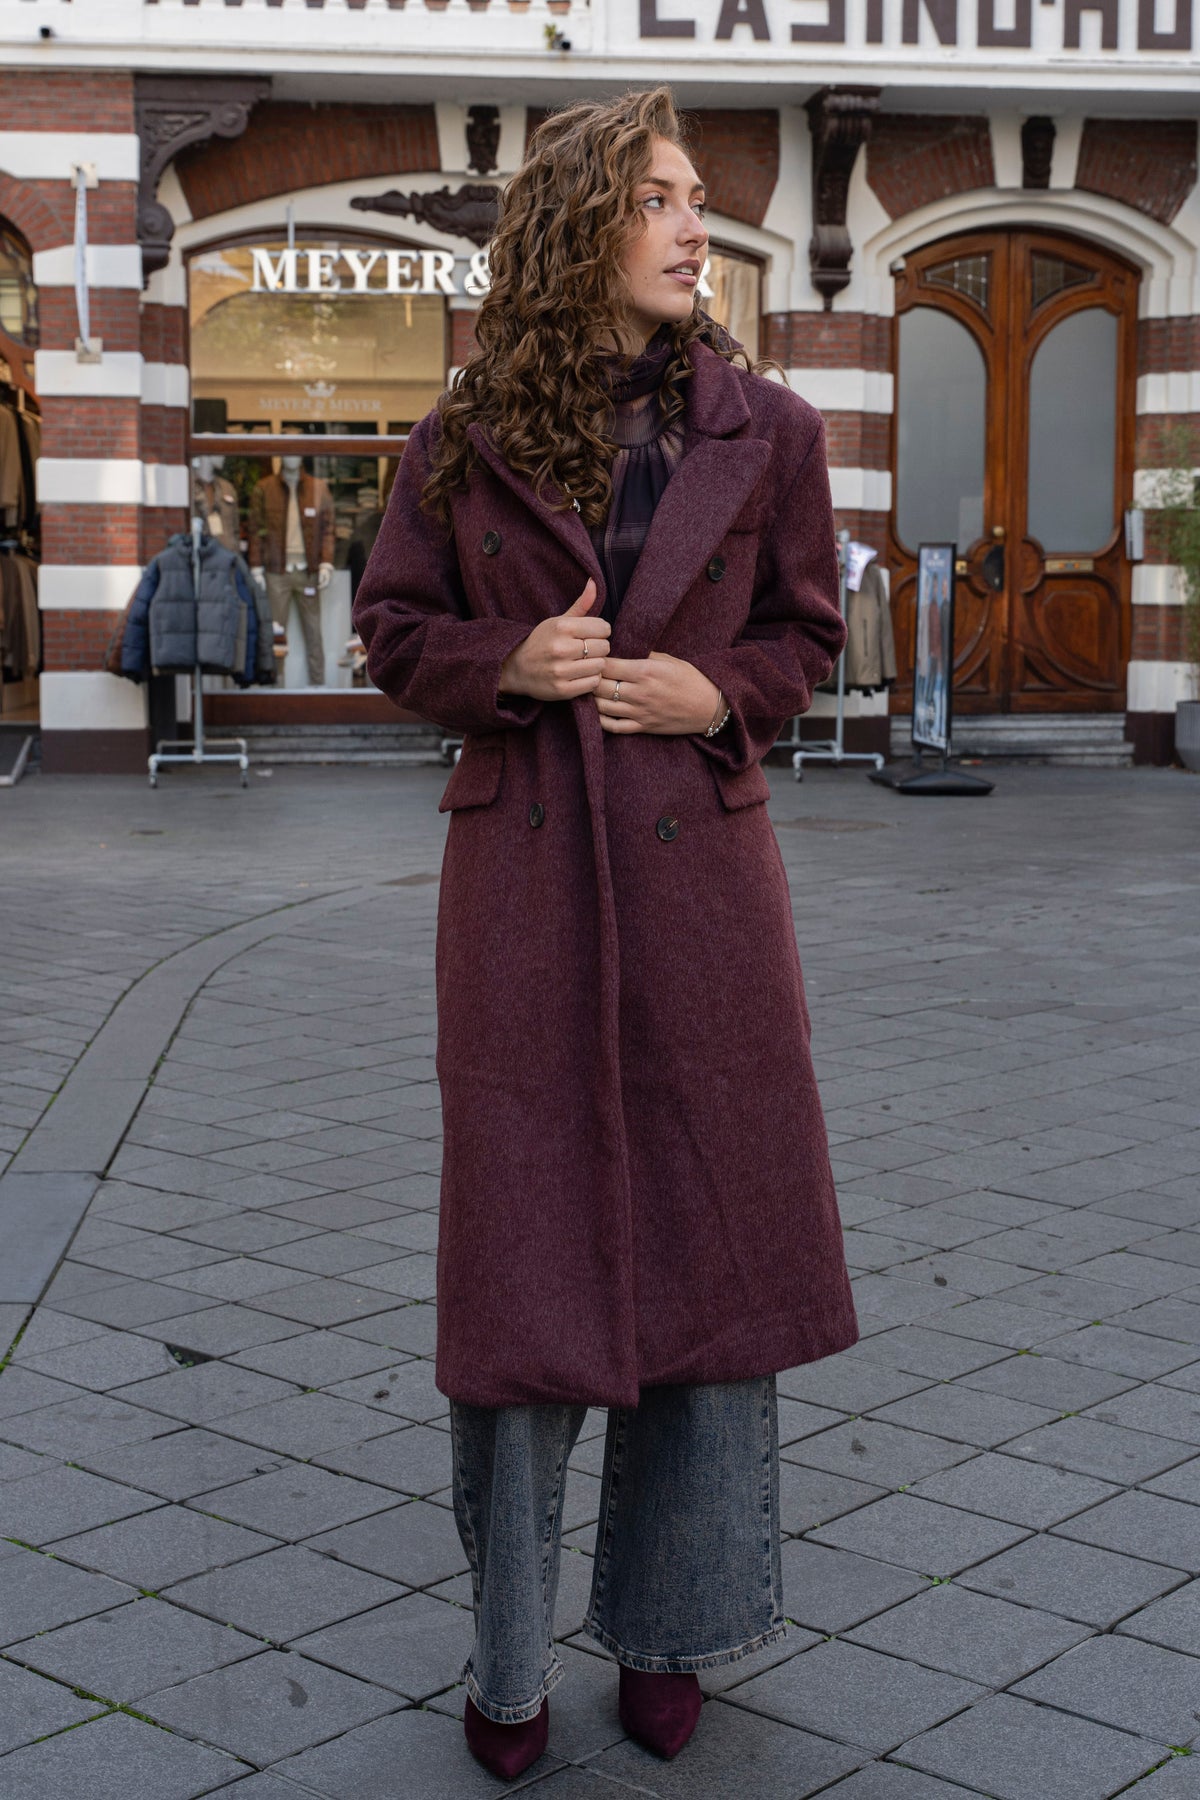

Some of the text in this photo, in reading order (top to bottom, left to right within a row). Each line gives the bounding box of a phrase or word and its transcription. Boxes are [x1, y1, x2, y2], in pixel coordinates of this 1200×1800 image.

[251, 249, 459, 295] MEYER
[259, 399, 312, 411] MEYER
[329, 399, 382, 412] MEYER
